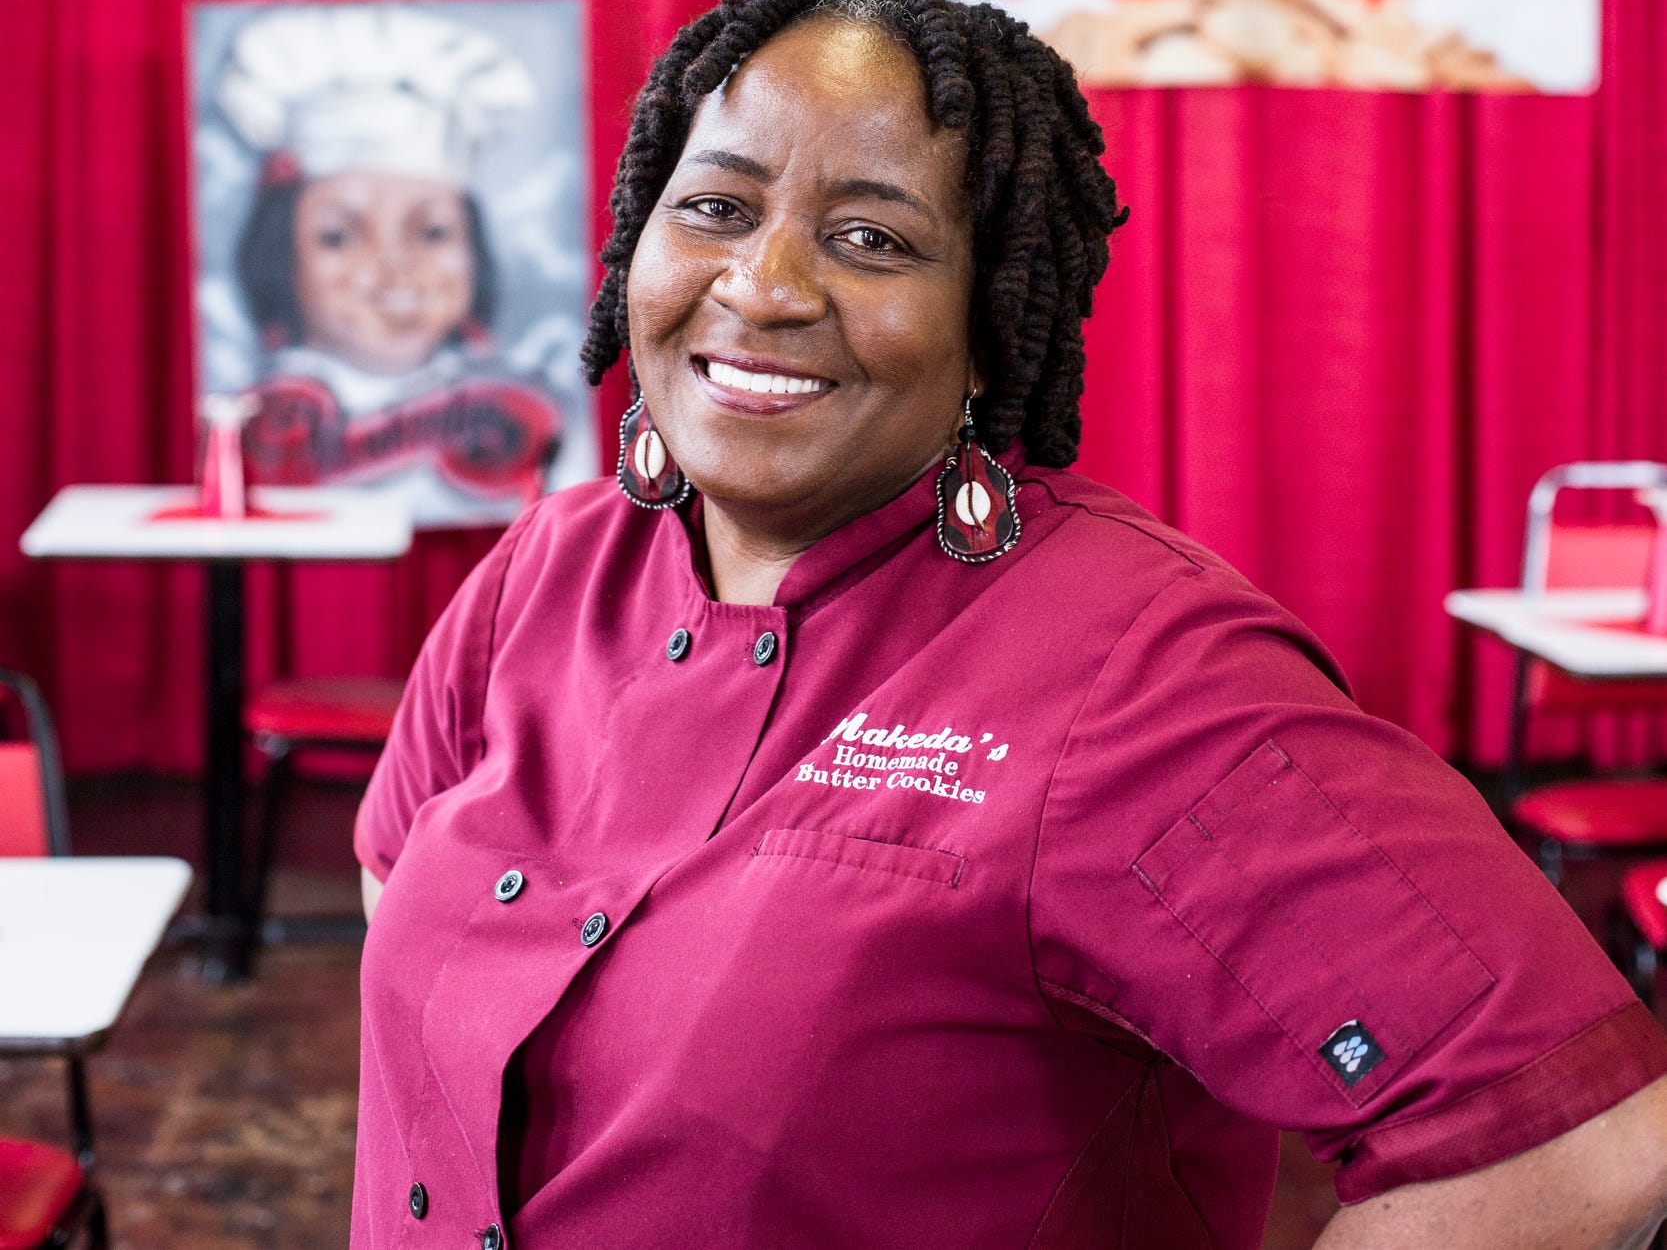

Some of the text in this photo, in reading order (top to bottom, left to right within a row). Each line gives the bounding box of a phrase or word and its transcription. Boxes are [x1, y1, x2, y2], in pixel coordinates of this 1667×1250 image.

[832, 743, 959, 776] Homemade
[794, 760, 986, 805] Butter Cookies
